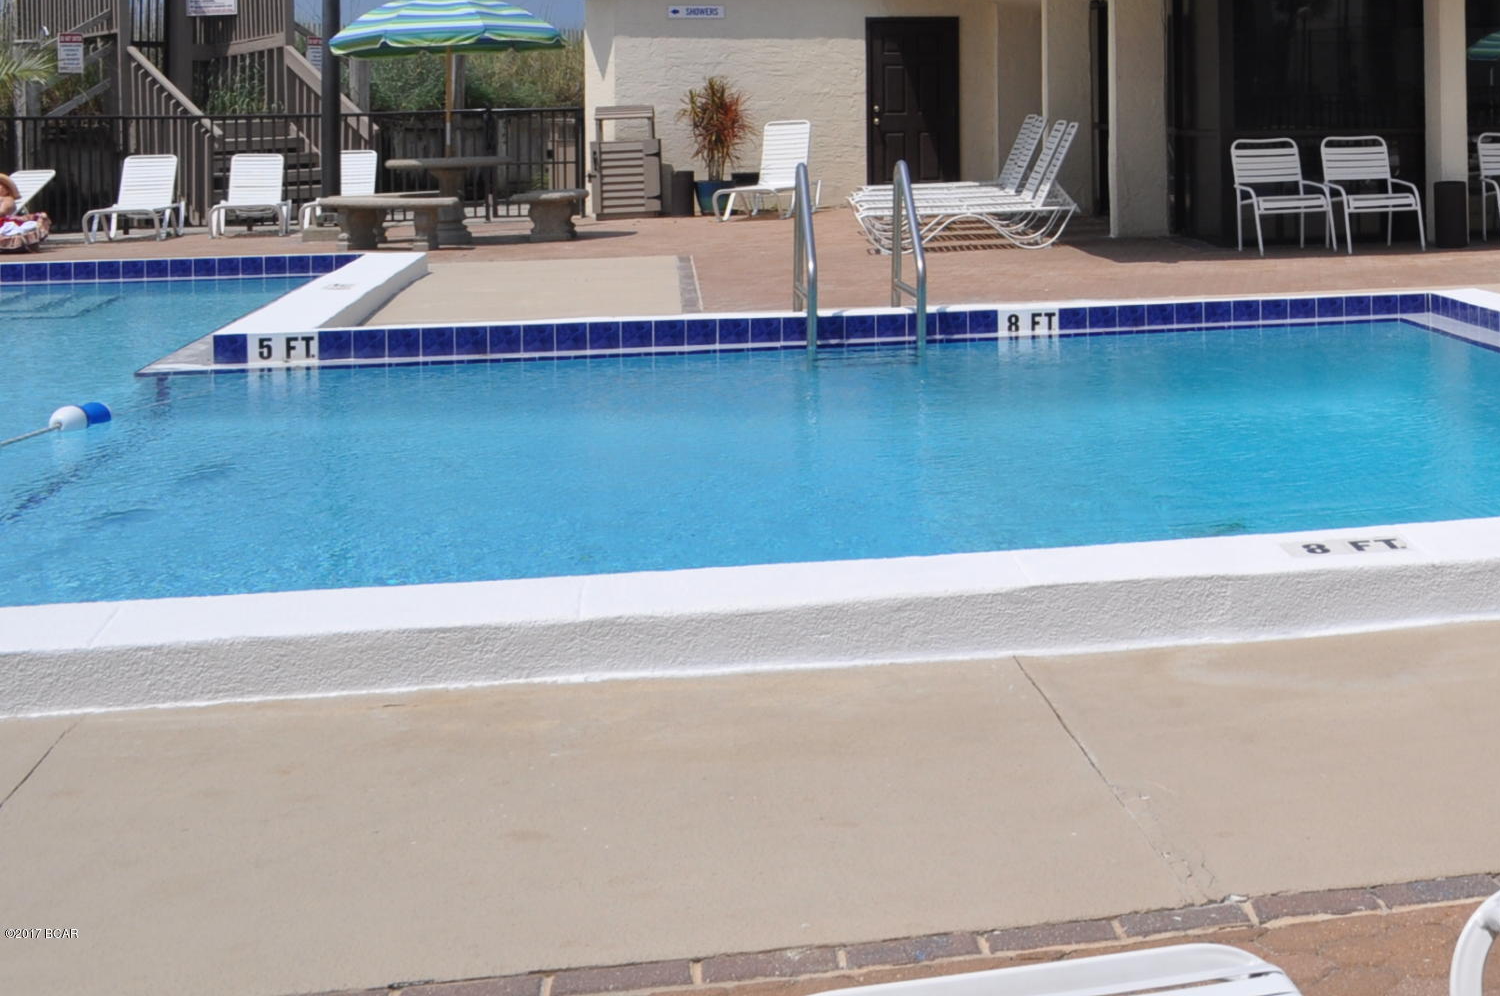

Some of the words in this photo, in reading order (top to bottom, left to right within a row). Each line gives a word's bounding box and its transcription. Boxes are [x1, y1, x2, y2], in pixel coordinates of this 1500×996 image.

[686, 7, 719, 16] SHOWERS
[1007, 313, 1020, 332] 8
[258, 337, 272, 360] 5
[285, 336, 315, 359] FT.
[1301, 543, 1331, 554] 8
